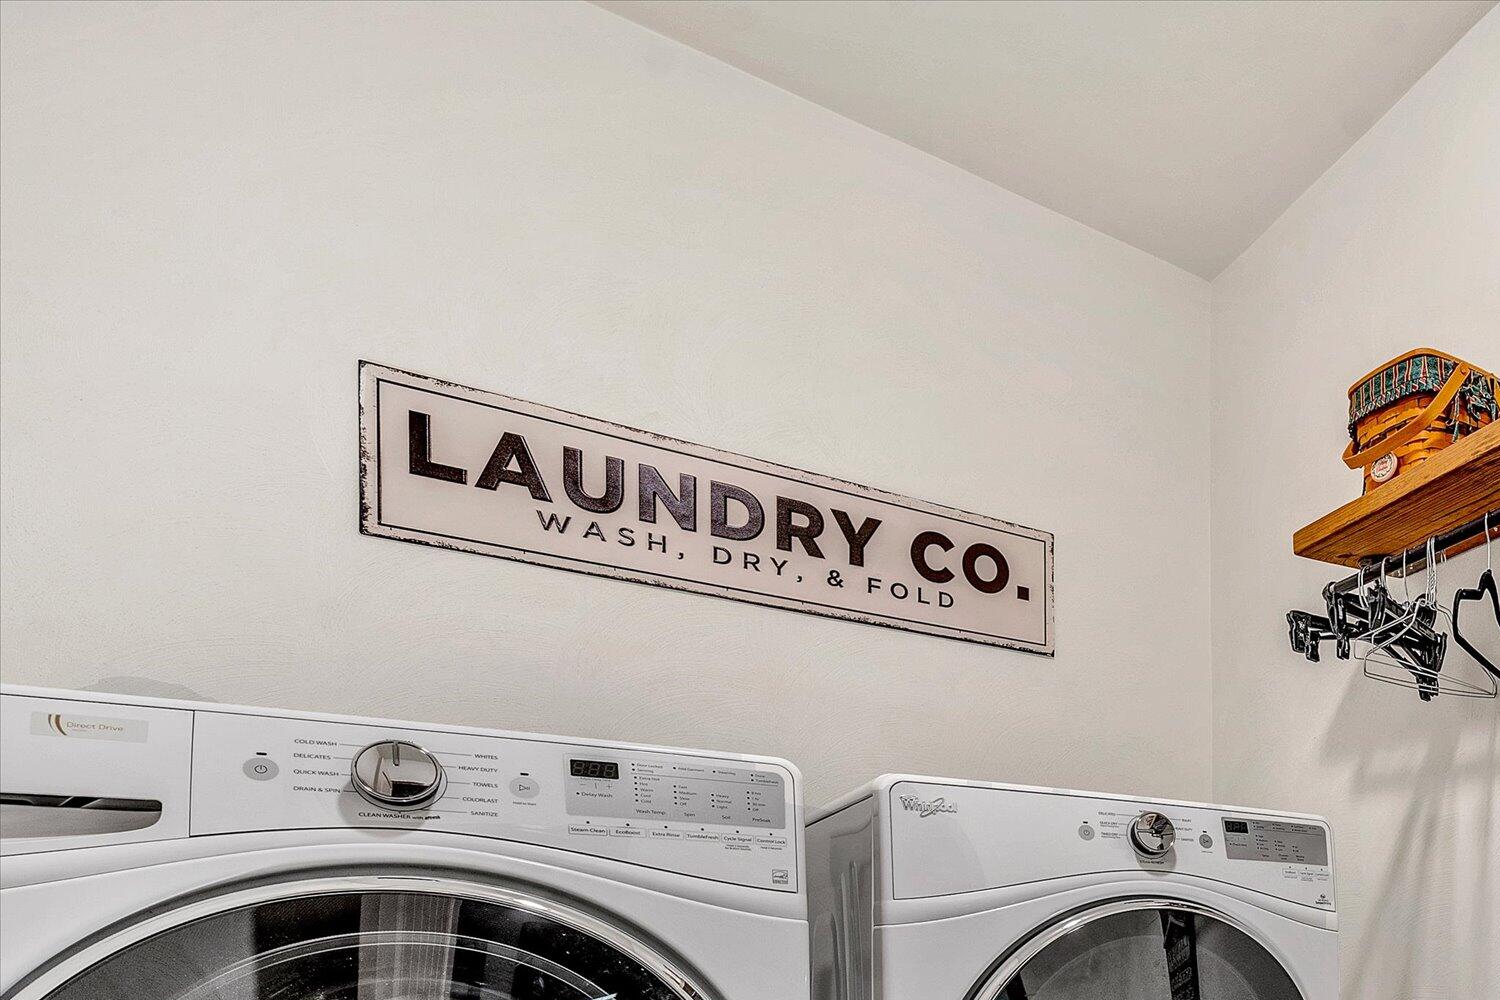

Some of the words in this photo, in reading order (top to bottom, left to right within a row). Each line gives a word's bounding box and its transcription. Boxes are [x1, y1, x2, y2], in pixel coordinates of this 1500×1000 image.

[408, 409, 882, 568] LAUNDRY
[910, 530, 1030, 601] CO.
[536, 510, 684, 560] WASH,
[713, 546, 803, 583] DRY,
[826, 570, 844, 588] &
[867, 577, 954, 608] FOLD
[293, 752, 331, 760] DELICATES
